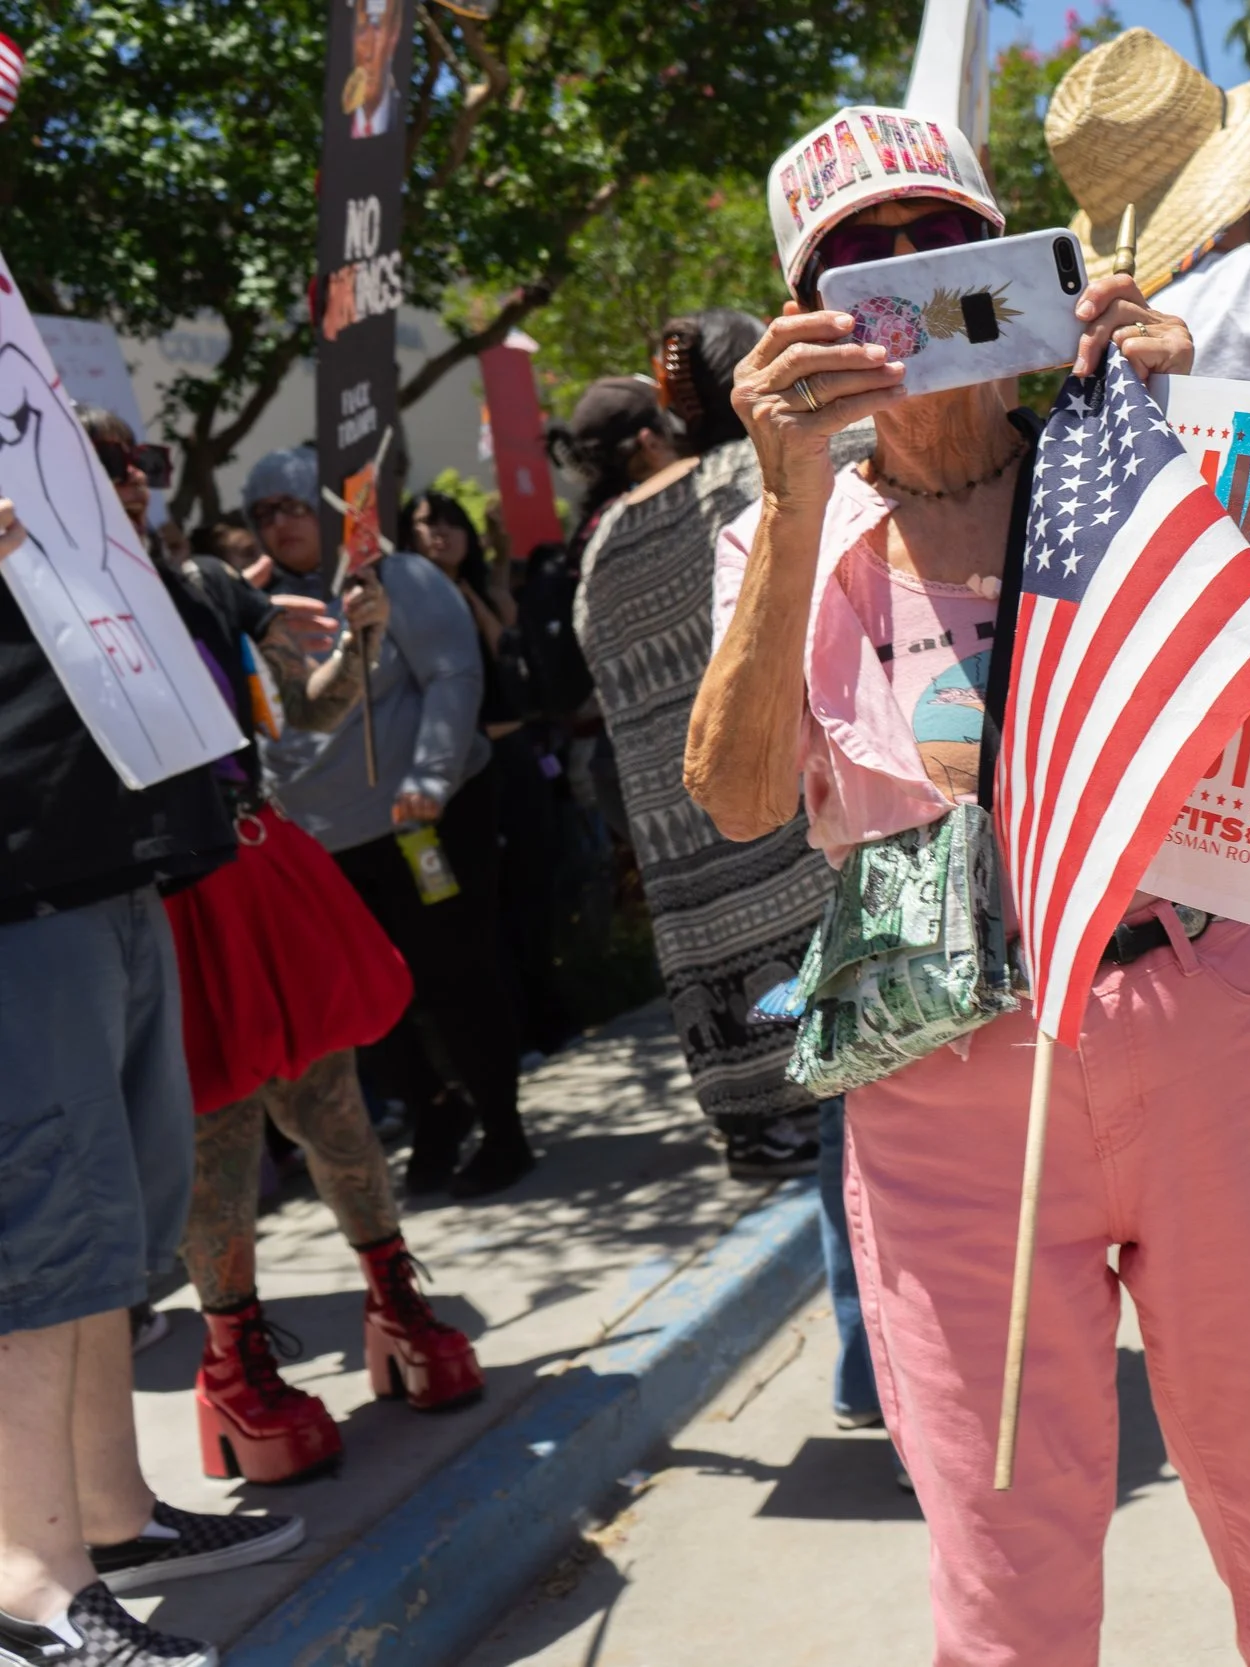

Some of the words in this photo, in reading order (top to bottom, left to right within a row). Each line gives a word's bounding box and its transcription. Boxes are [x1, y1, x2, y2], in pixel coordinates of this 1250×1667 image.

[780, 120, 872, 232] PURA
[860, 115, 964, 186] VIDA
[344, 195, 380, 260] NO
[1165, 829, 1221, 856] SSMAN
[1226, 845, 1250, 864] RO
[1173, 805, 1245, 843] FITS
